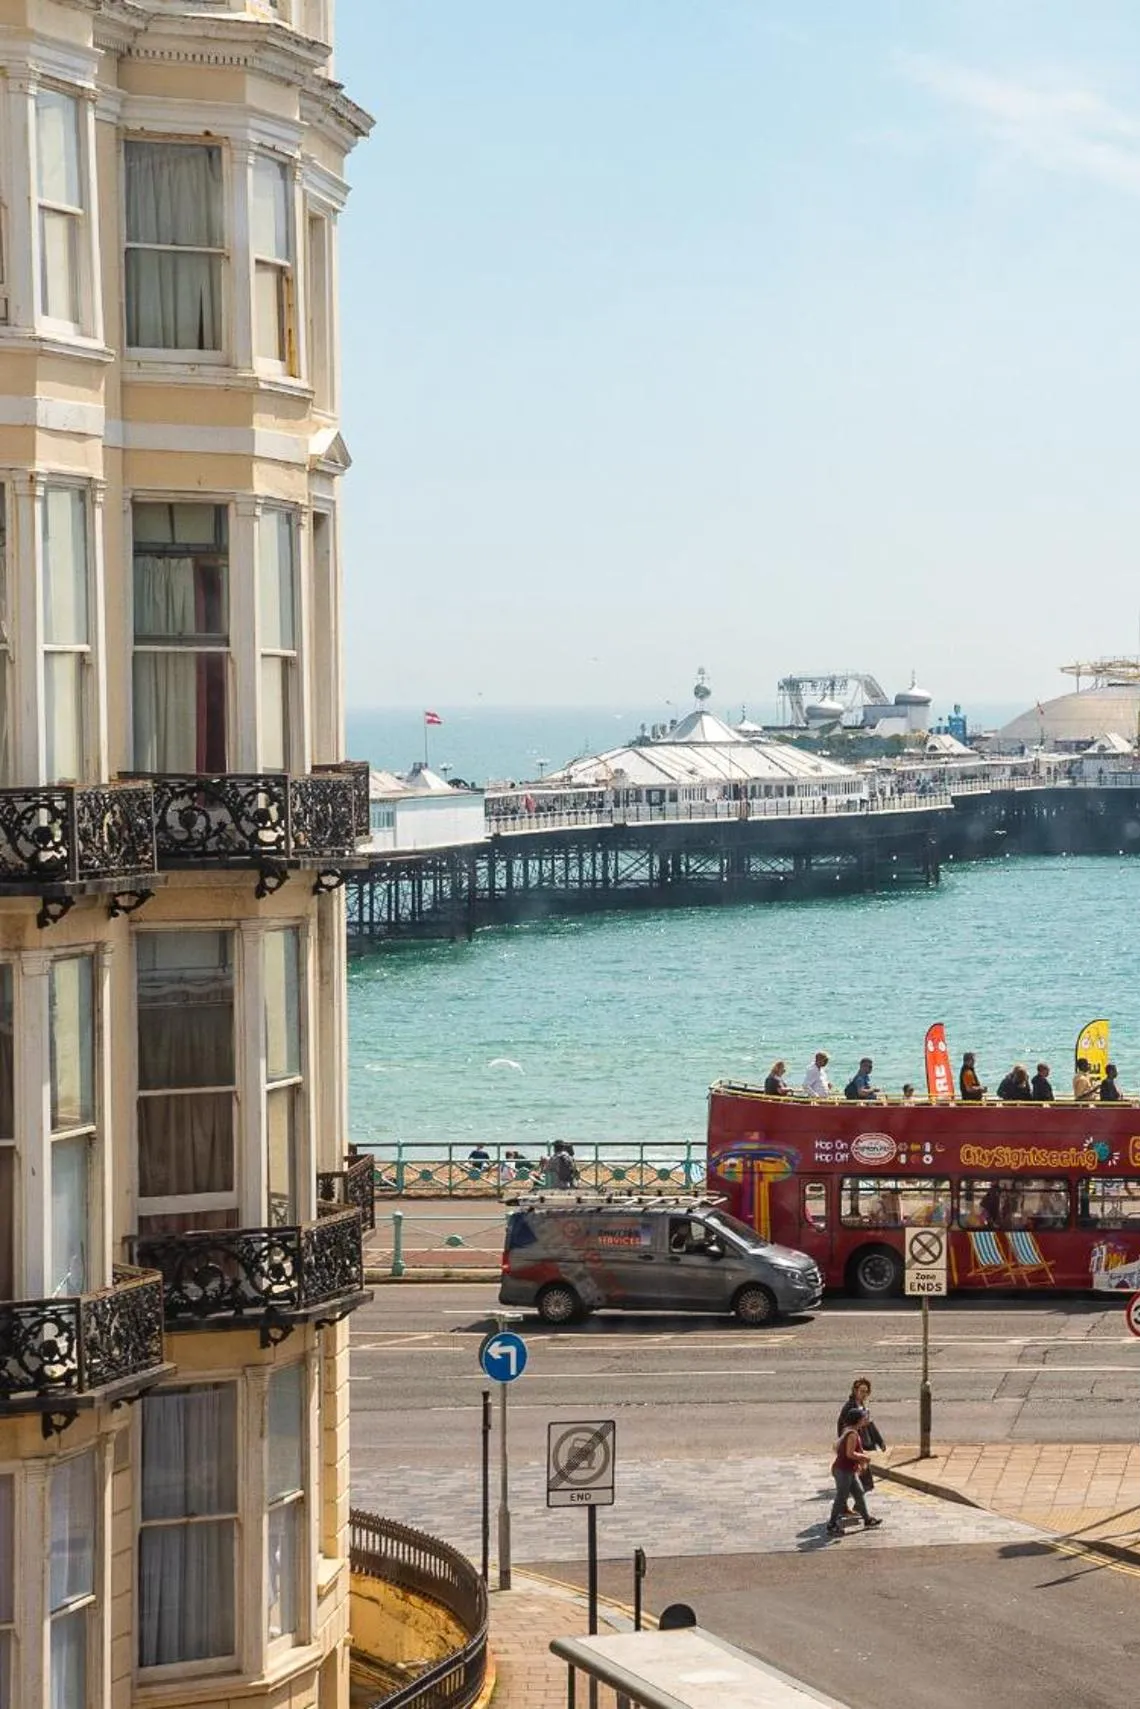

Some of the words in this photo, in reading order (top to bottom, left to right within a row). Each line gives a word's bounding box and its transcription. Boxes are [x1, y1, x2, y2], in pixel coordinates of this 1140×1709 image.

[815, 1140, 833, 1150] Hop
[835, 1140, 848, 1150] On
[815, 1153, 833, 1163] Hop
[835, 1153, 849, 1162] Off
[910, 1282, 943, 1292] ENDS
[570, 1492, 592, 1502] END
